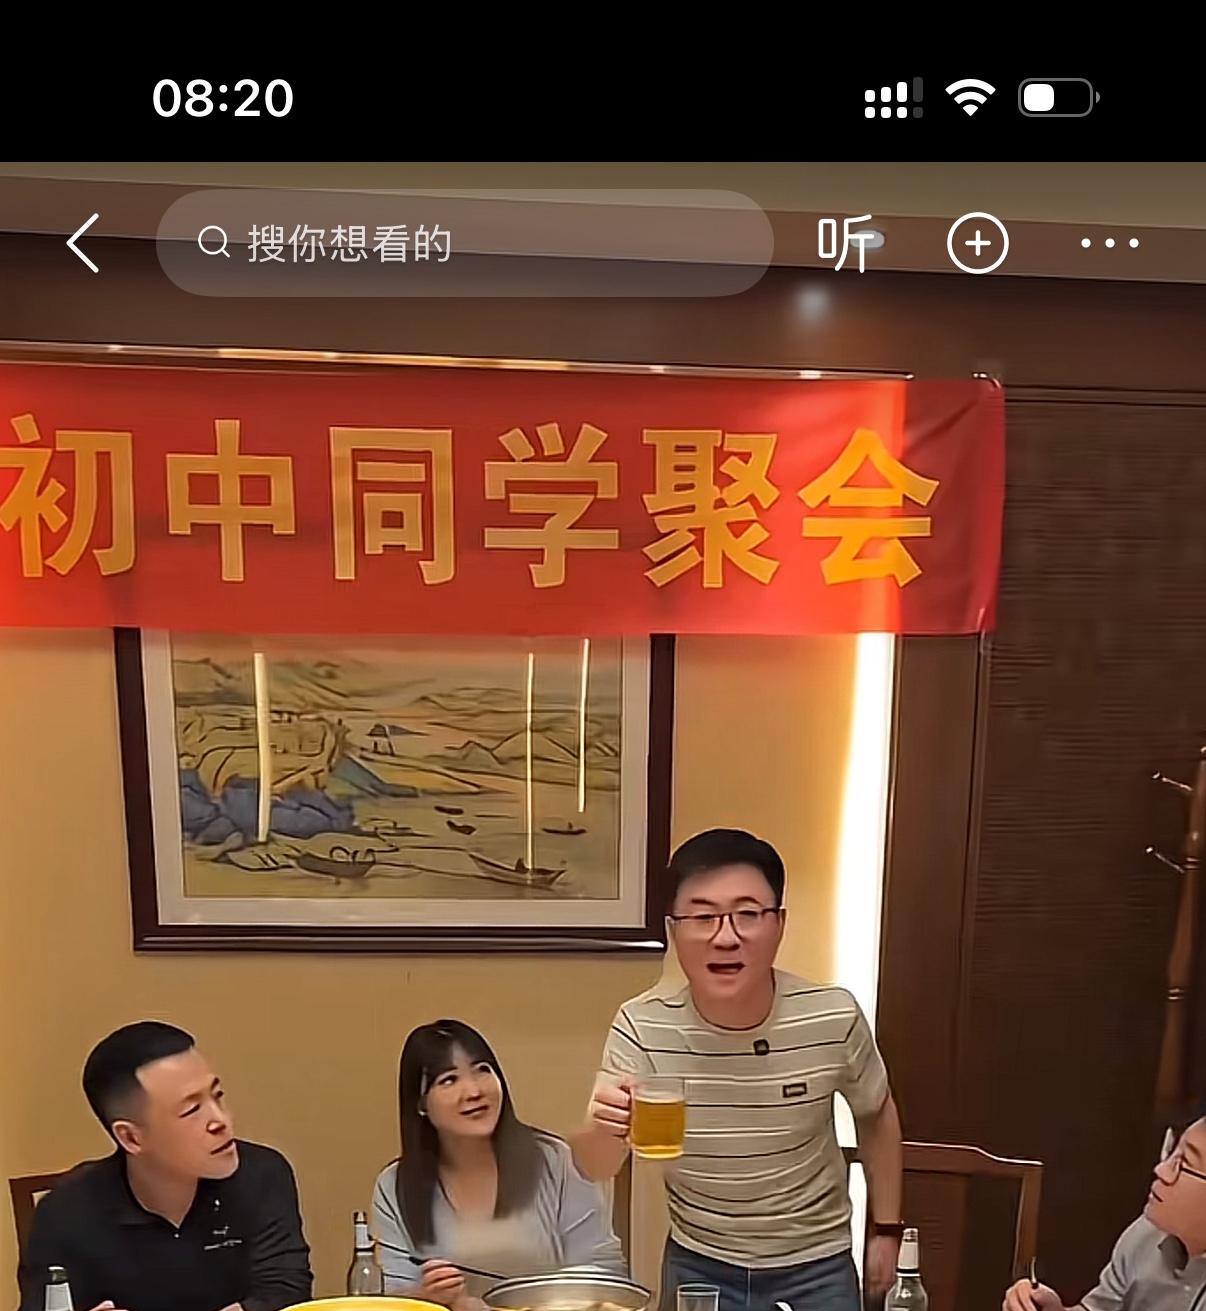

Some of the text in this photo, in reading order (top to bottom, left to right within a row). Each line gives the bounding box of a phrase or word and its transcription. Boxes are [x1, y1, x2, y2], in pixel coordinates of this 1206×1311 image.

[0, 413, 940, 588] 初中同学聚会
